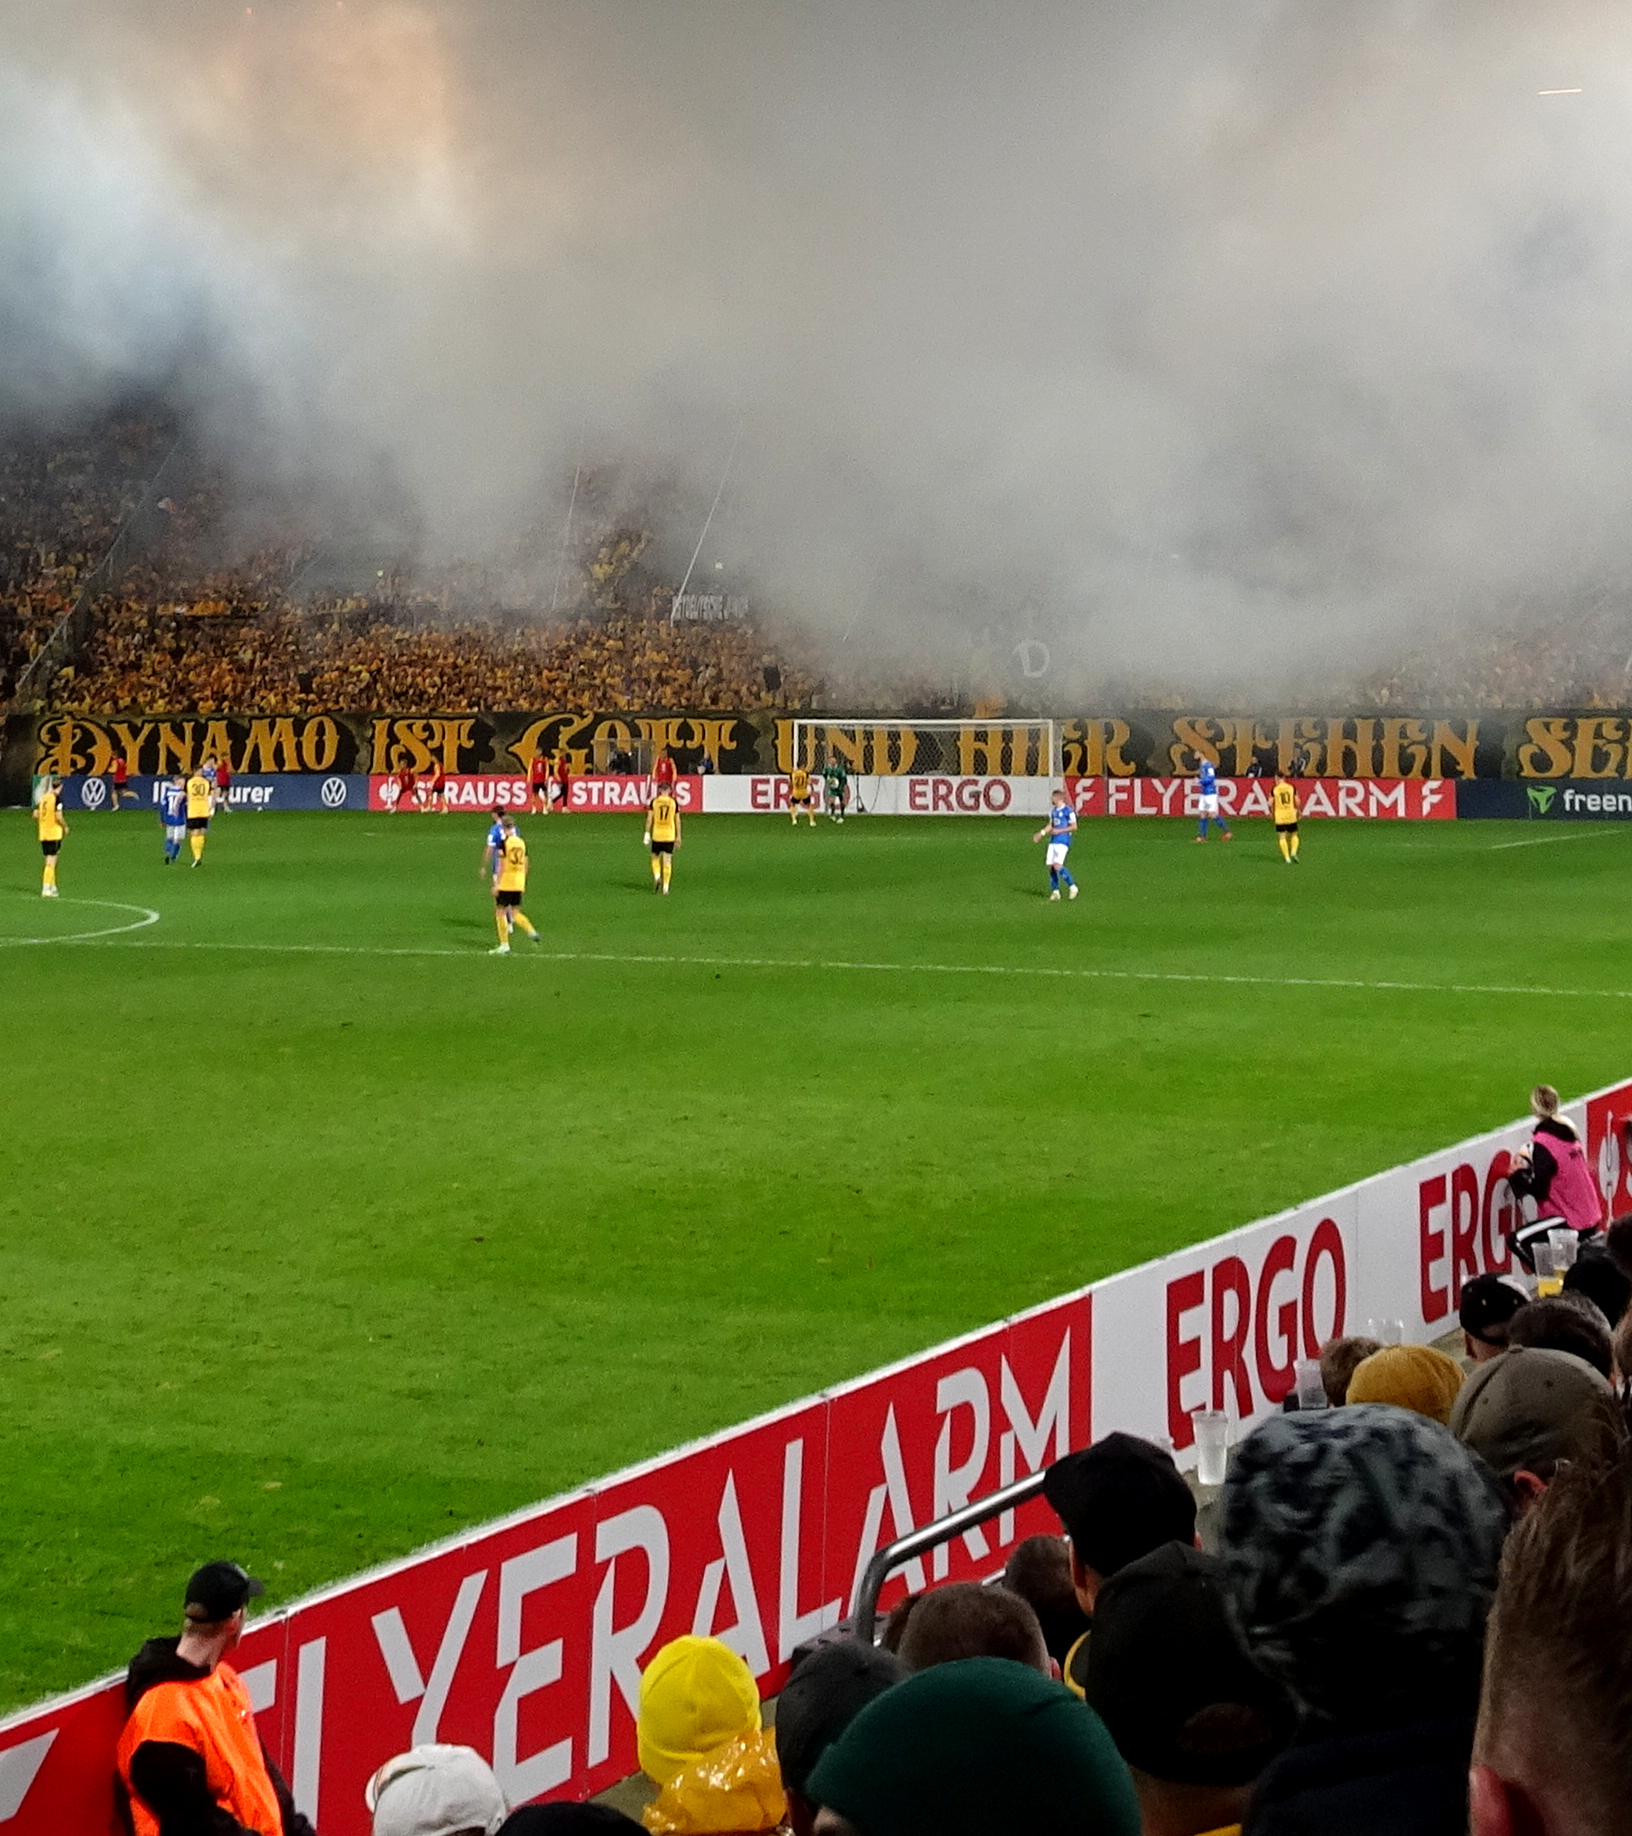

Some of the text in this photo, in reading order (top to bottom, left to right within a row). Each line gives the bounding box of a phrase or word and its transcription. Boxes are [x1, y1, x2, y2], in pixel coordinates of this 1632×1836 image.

[37, 715, 341, 775] DYNAMO
[369, 718, 475, 774] IST
[509, 711, 738, 774] GOTT
[775, 719, 919, 775] UND
[1169, 716, 1479, 779] STEHEN
[571, 781, 691, 806] STRAUS
[909, 778, 1012, 812] ERGO
[1108, 779, 1405, 817] FLYERAARM
[1419, 1150, 1536, 1324] ERG
[1166, 1217, 1347, 1451] ERGO
[241, 1325, 1072, 1836] LYERALARM
